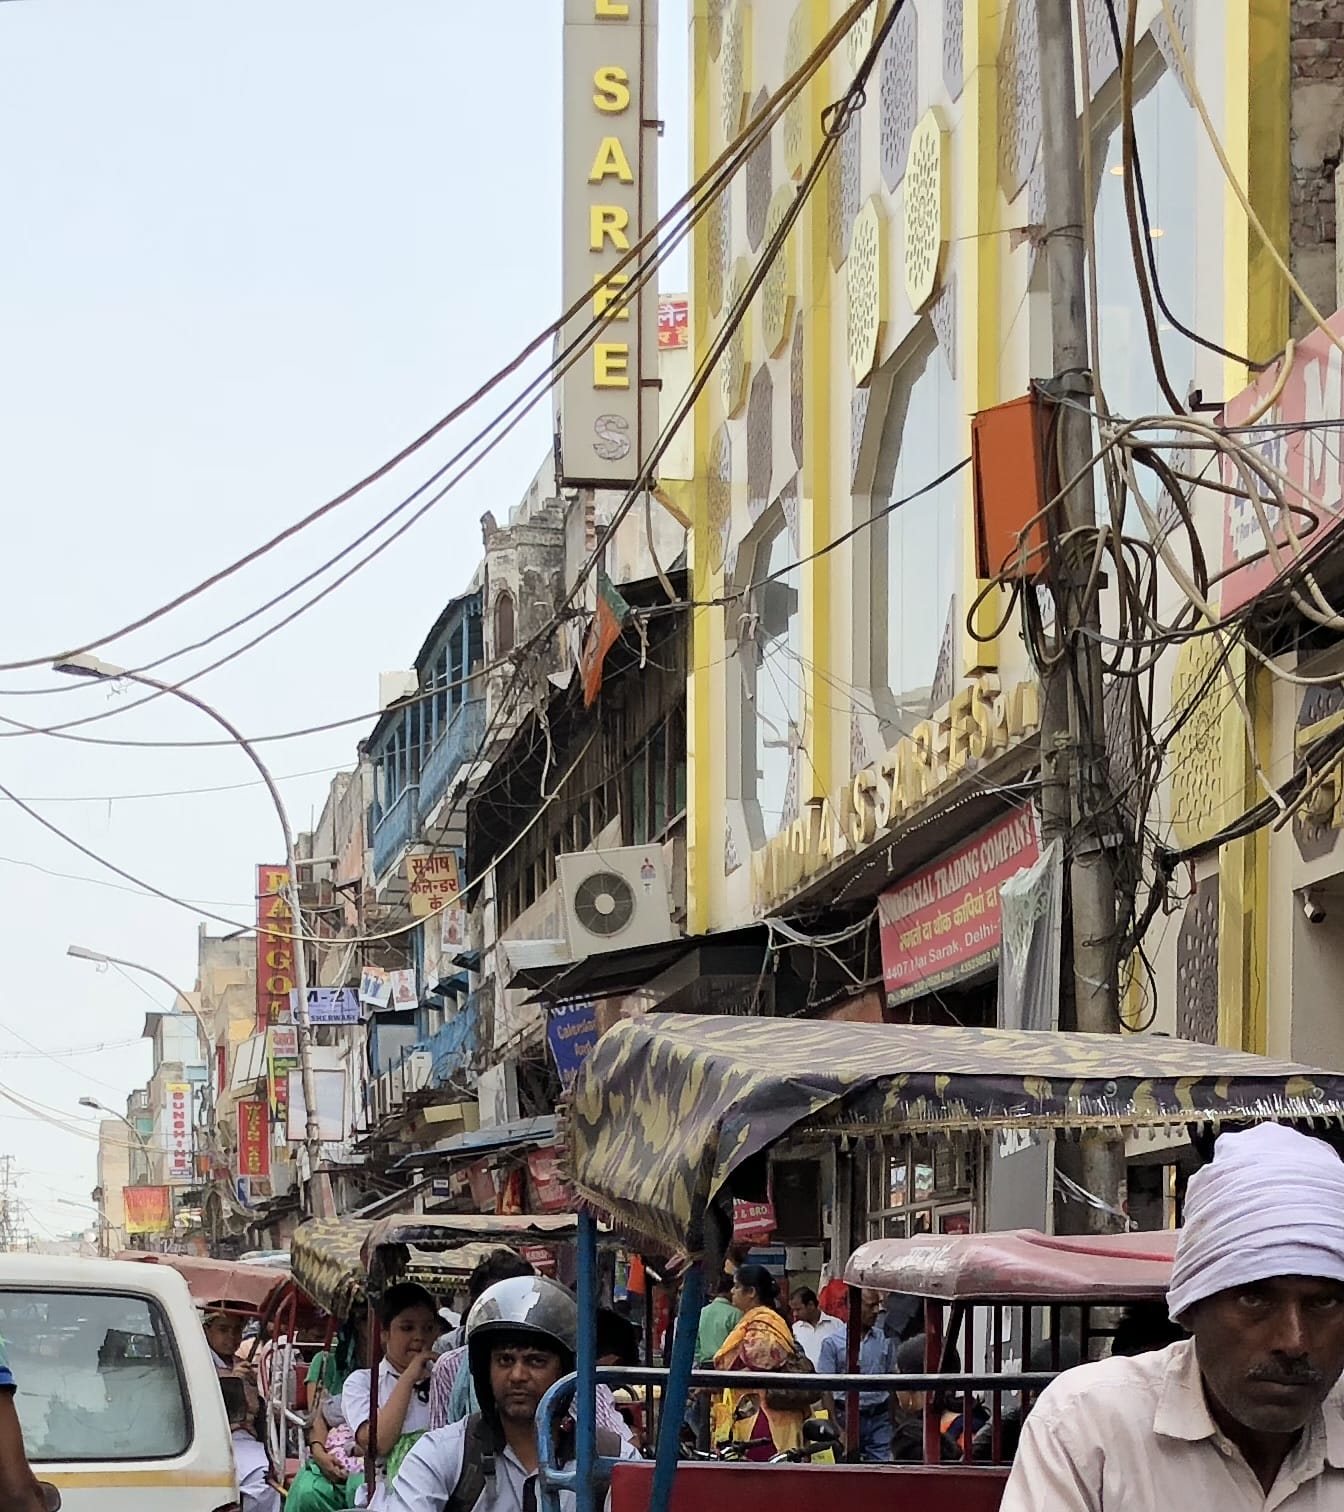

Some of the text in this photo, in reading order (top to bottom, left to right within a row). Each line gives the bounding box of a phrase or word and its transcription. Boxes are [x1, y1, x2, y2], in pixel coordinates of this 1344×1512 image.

[587, 66, 634, 462] SAREES
[935, 847, 981, 899] TRADING
[979, 814, 1033, 871] COMPANY
